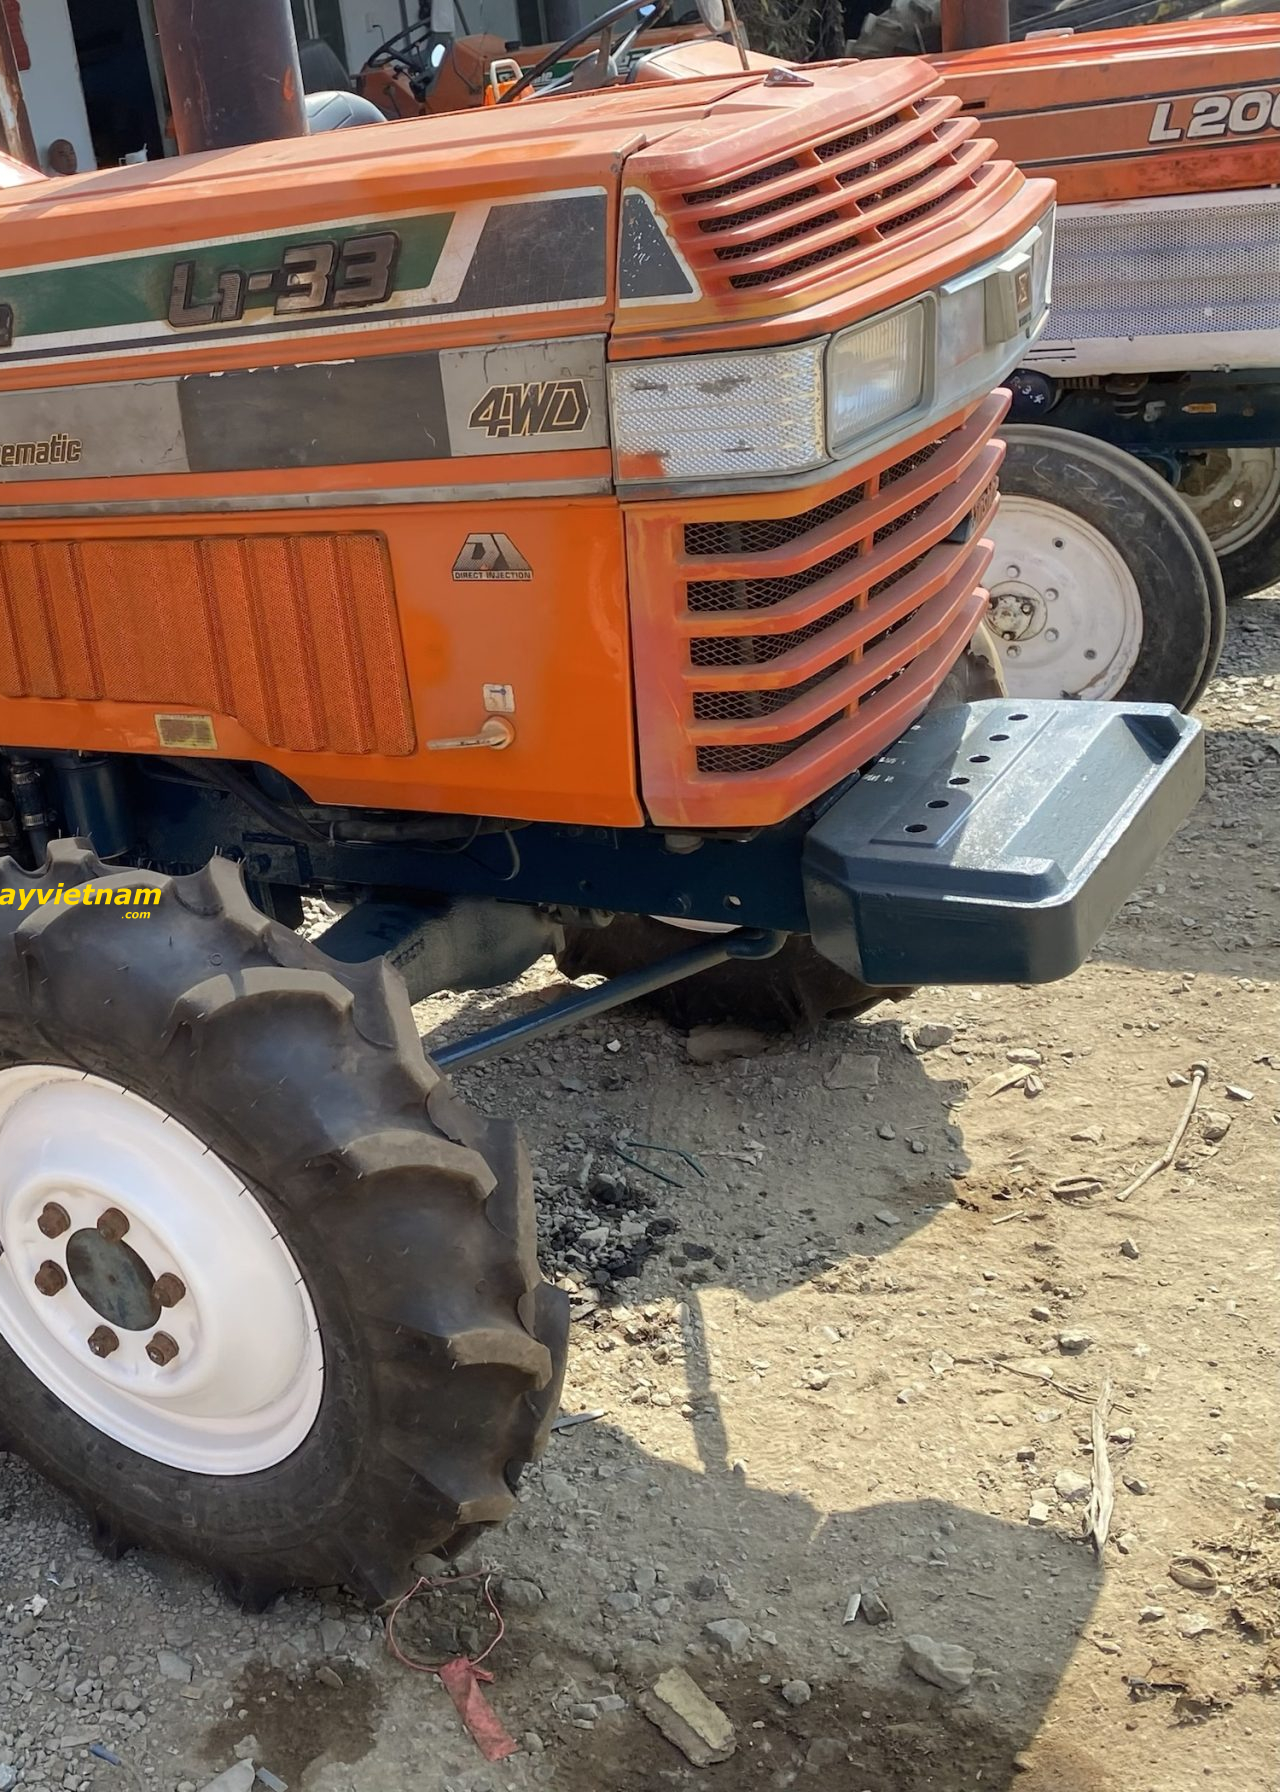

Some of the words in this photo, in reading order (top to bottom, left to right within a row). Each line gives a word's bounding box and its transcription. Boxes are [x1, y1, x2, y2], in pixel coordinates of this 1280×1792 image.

[1148, 90, 1280, 144] L20
[467, 379, 590, 438] 4WD
[455, 571, 483, 579] DIRECT
[486, 571, 531, 579] INJECTION
